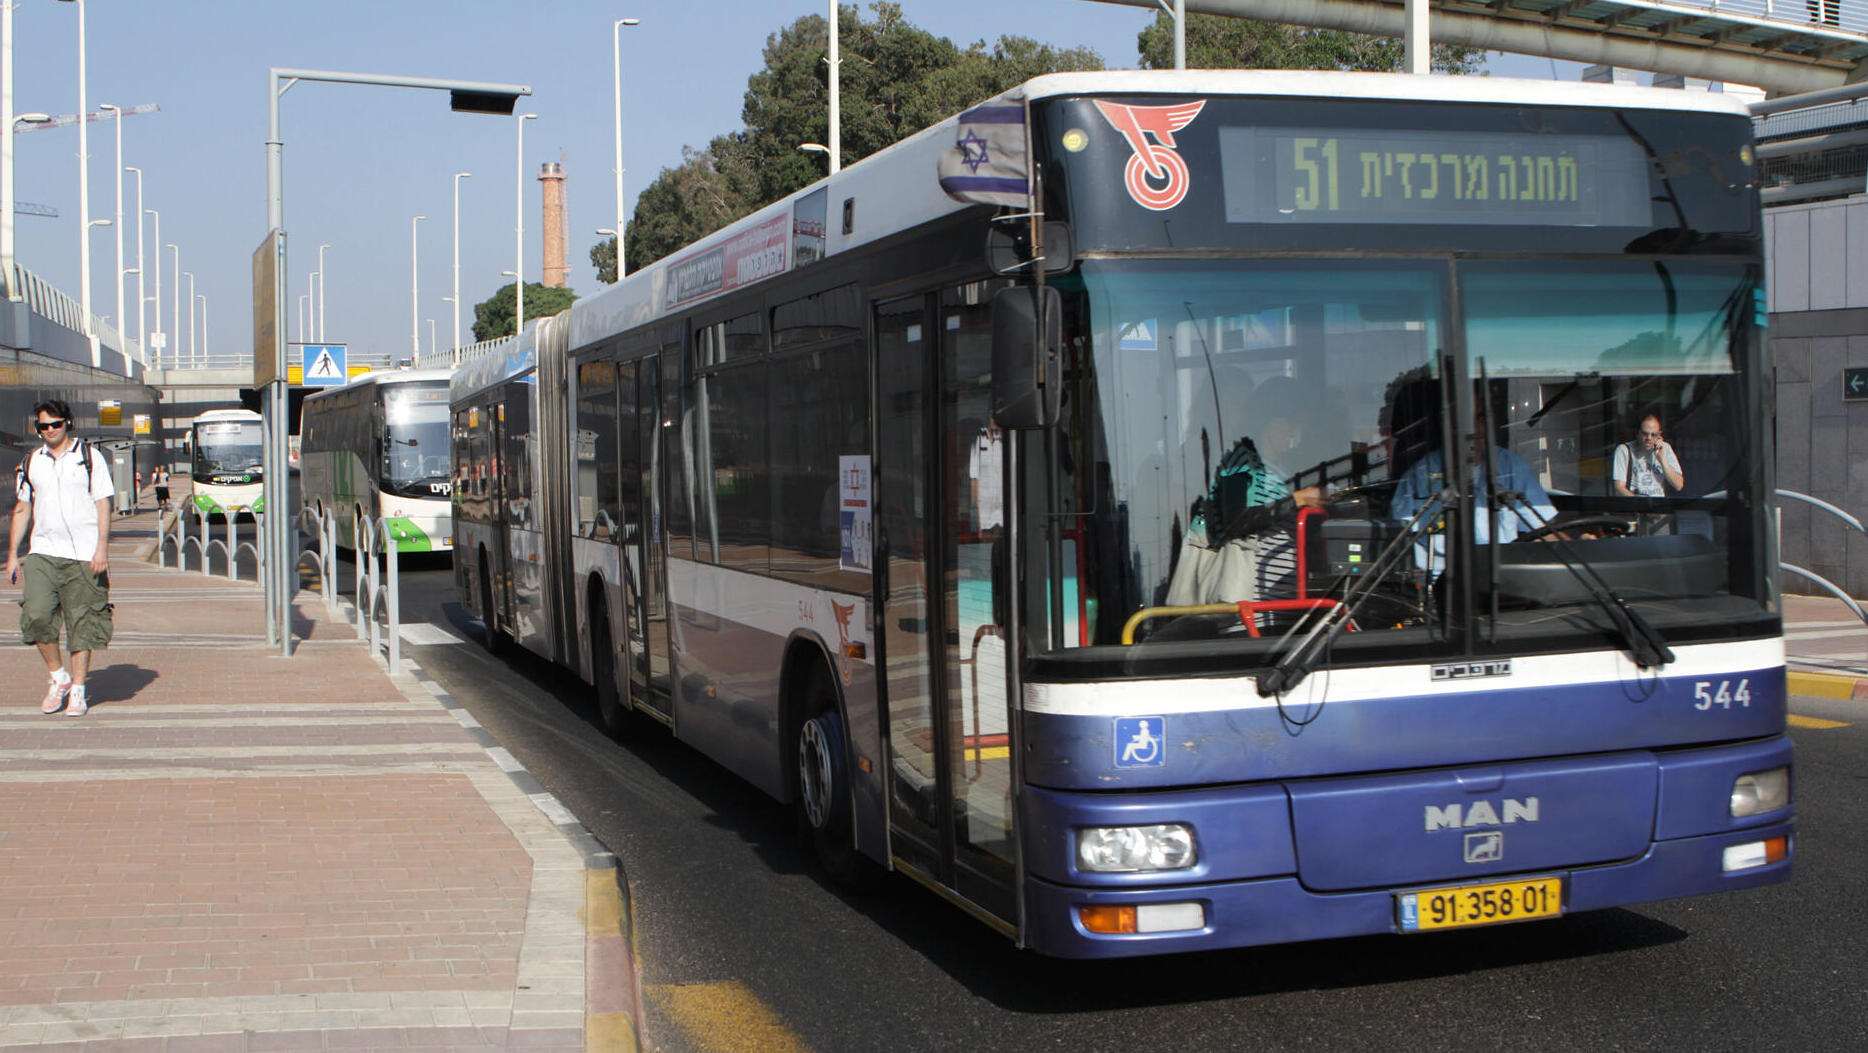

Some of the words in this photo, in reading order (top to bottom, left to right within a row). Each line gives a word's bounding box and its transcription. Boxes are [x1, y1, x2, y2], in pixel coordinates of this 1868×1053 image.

[1294, 137, 1339, 210] 51
[1360, 151, 1489, 200] מרכזית
[1498, 154, 1578, 201] תחנה
[430, 483, 451, 495] קים
[1694, 678, 1751, 711] 544
[1424, 796, 1539, 831] MAN
